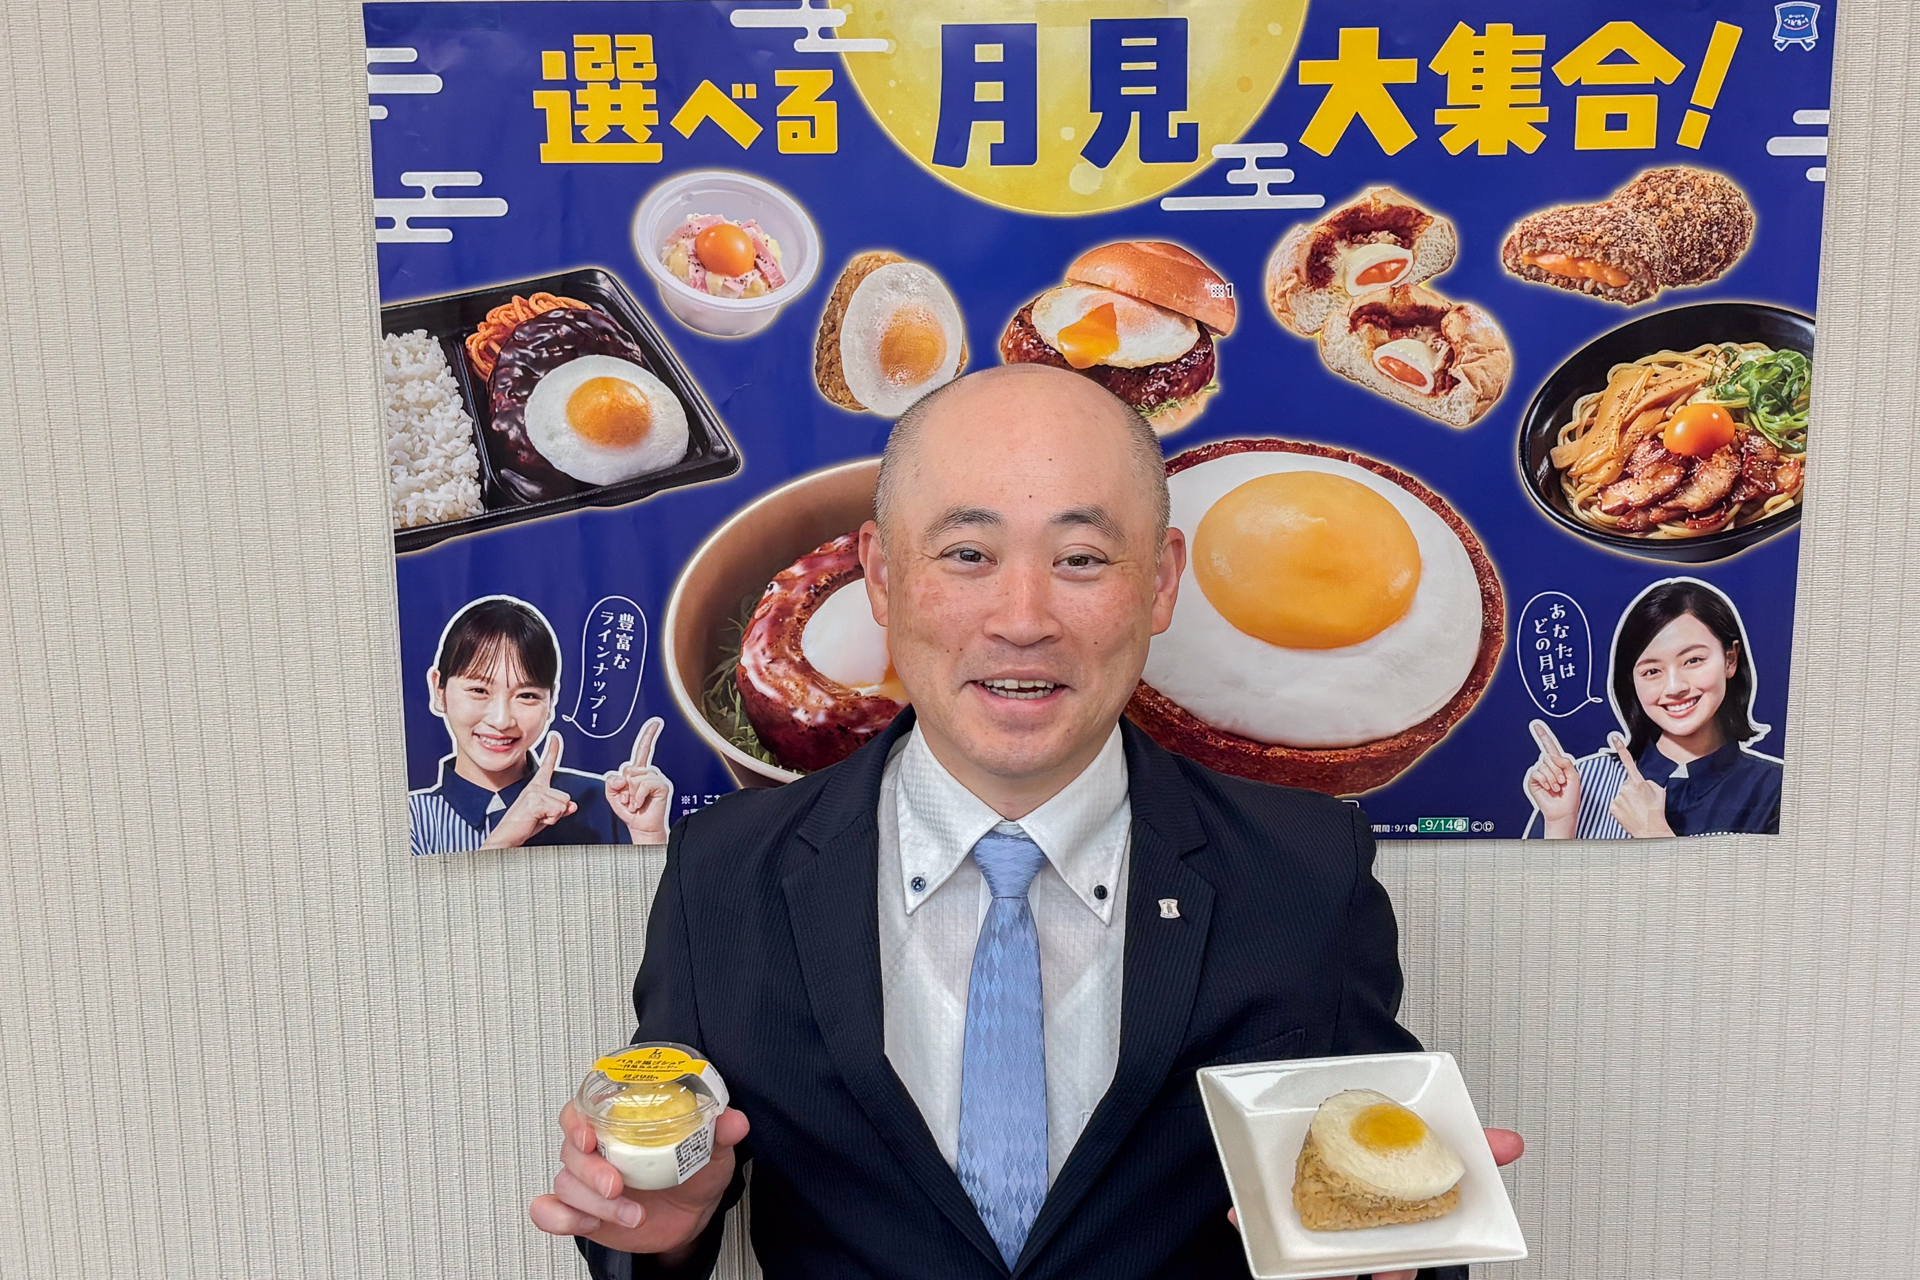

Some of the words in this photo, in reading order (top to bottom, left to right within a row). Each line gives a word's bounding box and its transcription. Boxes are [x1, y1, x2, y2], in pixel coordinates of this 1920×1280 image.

[533, 34, 838, 164] 選べる
[931, 18, 1200, 170] 月見
[1298, 20, 1743, 157] 大集合!
[590, 611, 615, 728] ラインナップ!
[613, 612, 635, 670] 豊富な
[1534, 618, 1558, 709] どの月見?
[1549, 603, 1576, 680] あなたは
